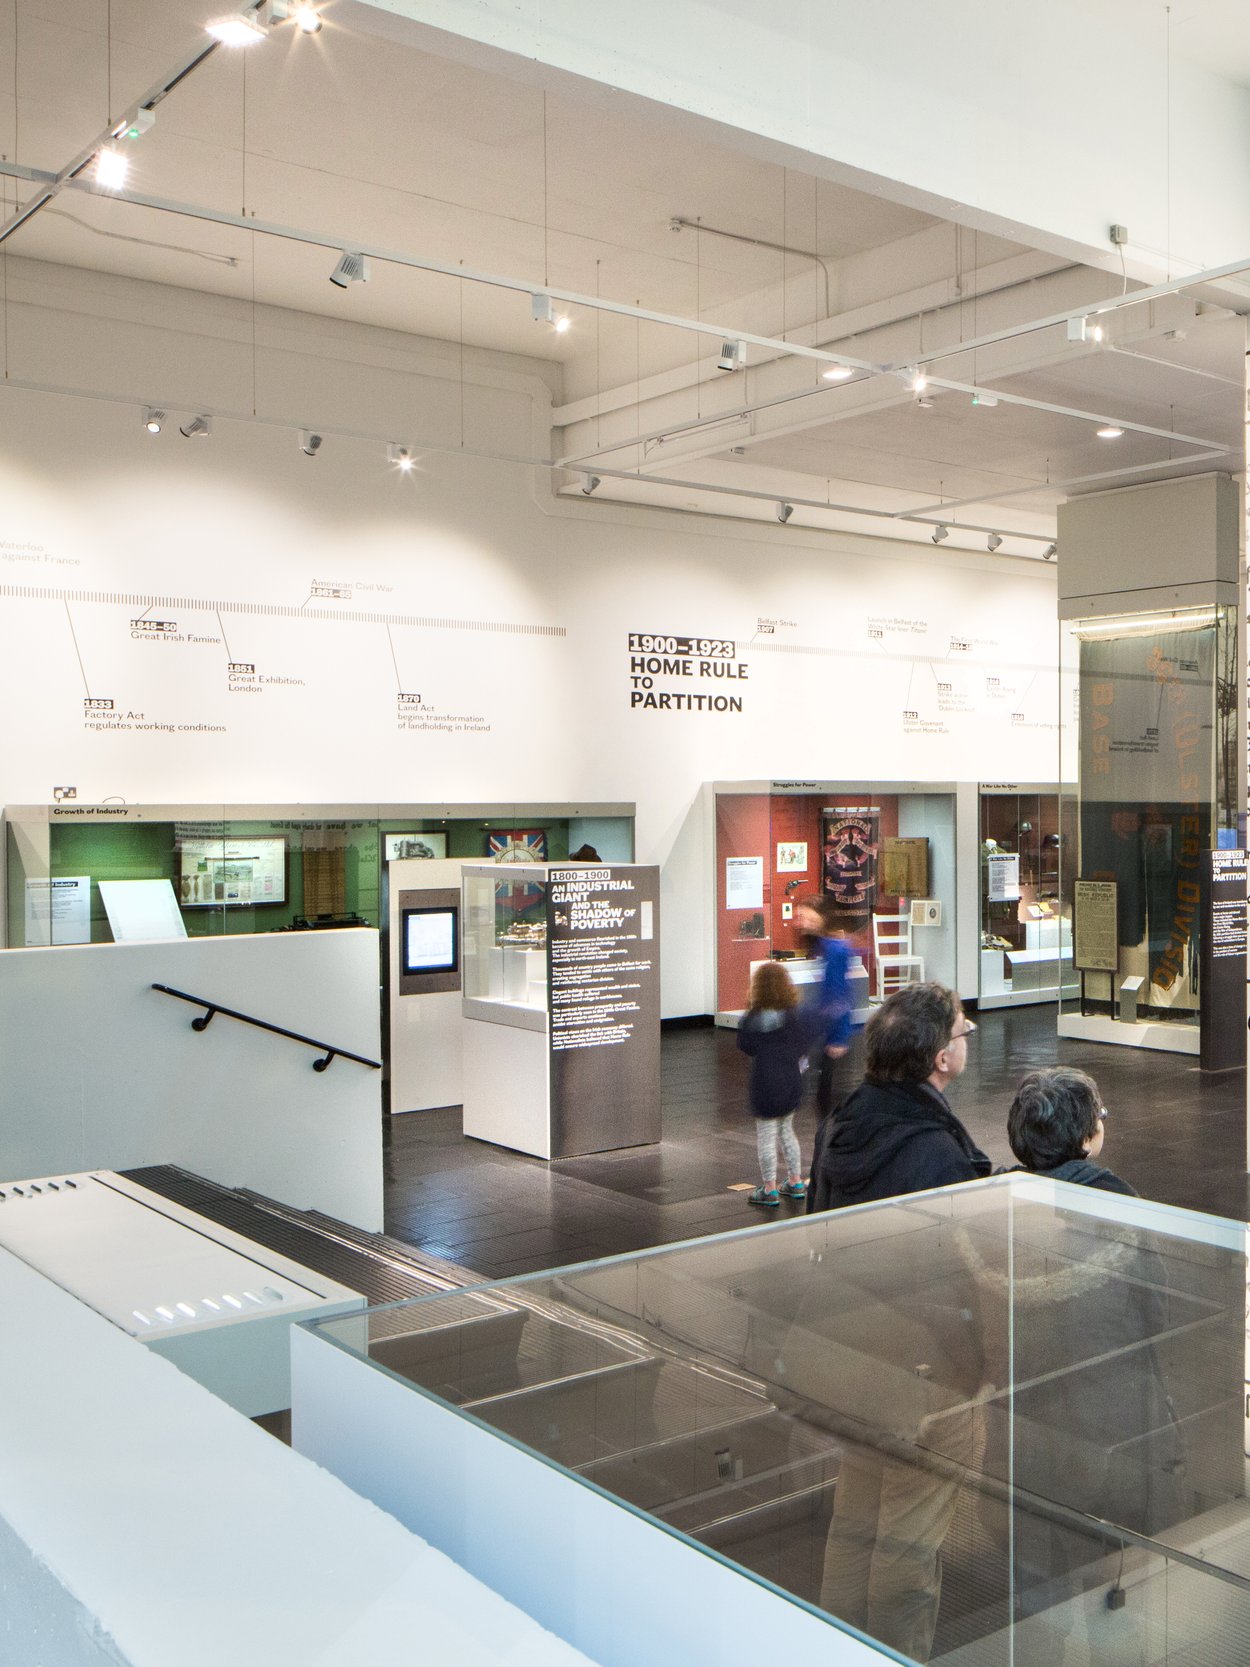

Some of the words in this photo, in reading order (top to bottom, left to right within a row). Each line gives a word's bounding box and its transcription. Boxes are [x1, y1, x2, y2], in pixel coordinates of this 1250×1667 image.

[2, 553, 40, 563] against
[44, 554, 80, 565] France
[311, 579, 352, 589] American
[356, 582, 374, 591] Civil
[376, 584, 393, 592] War
[758, 618, 778, 626] Belfast
[780, 619, 798, 628] Strike
[131, 631, 159, 641] Great
[163, 632, 184, 642] Irish
[187, 634, 221, 644] Famine
[228, 663, 254, 674] 1851
[631, 657, 693, 676] HOME
[699, 661, 749, 679] RULE
[228, 674, 255, 683] Great
[259, 675, 305, 686] Exhibition,
[630, 676, 654, 689] TO
[228, 684, 262, 693] London
[84, 699, 113, 709] 1833
[631, 691, 743, 712] PARTITION
[398, 704, 417, 712] Land
[84, 710, 124, 721] Factory
[127, 712, 144, 720] Act
[397, 712, 424, 722] begins
[426, 714, 485, 723] transformation
[84, 720, 132, 731] regulates
[135, 722, 175, 733] working
[178, 722, 227, 732] conditions
[398, 722, 407, 730] of
[408, 722, 453, 732] landholding
[464, 724, 491, 732] Ireland
[97, 808, 128, 816] Industry
[1213, 860, 1232, 868] HOME
[1213, 873, 1247, 882] PARTITION
[552, 885, 565, 893] AN
[567, 880, 635, 892] INDUSTRIAL
[552, 892, 589, 903] GIANT
[572, 902, 591, 910] AND
[592, 901, 610, 909] THE
[570, 908, 622, 920] SHADOW
[624, 909, 636, 917] OF
[570, 918, 624, 930] POVERTY
